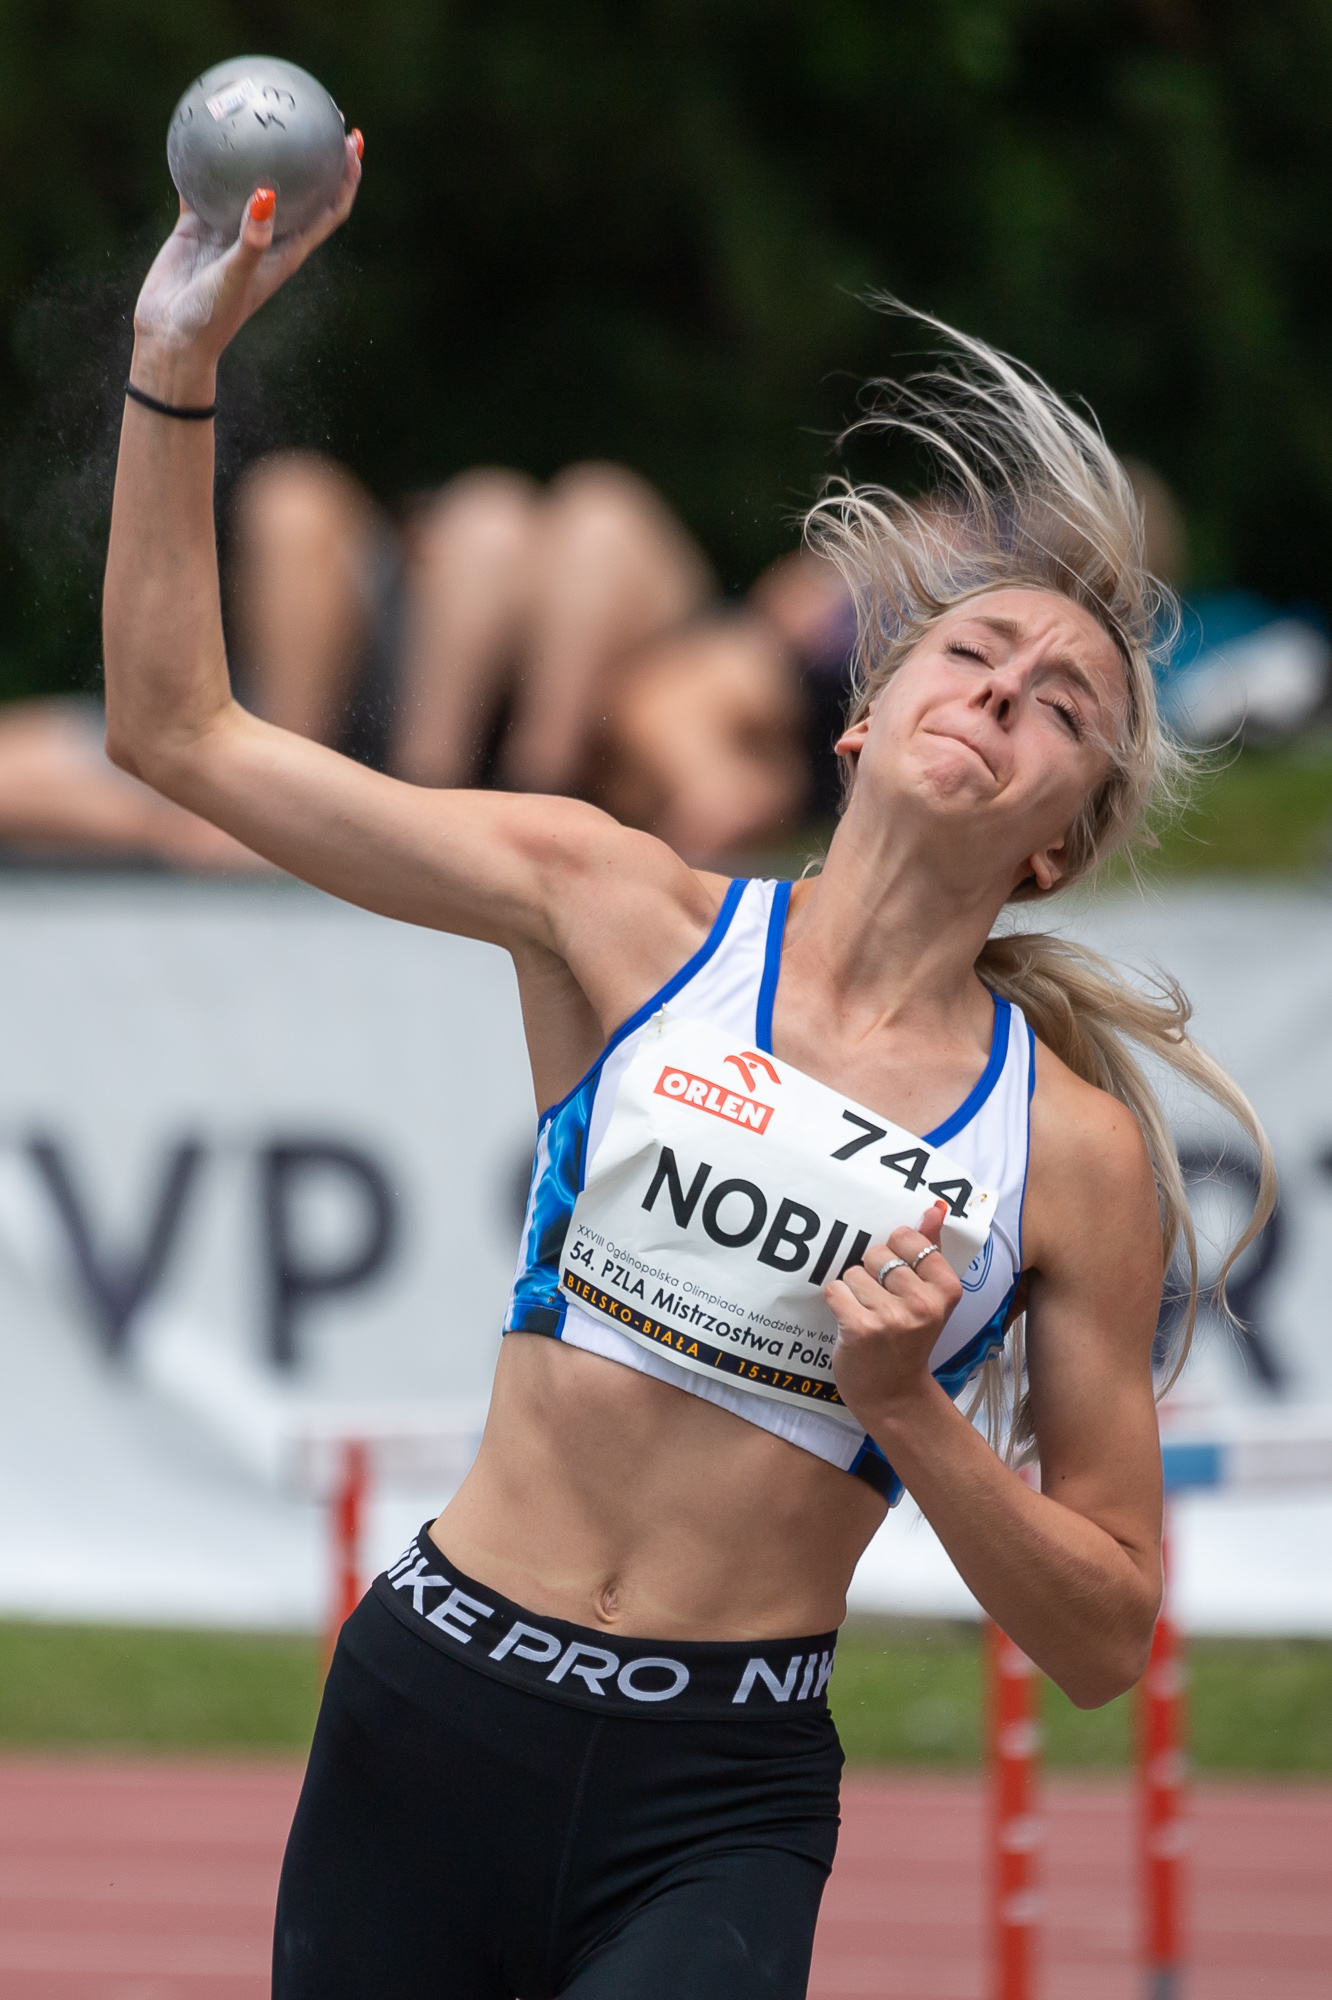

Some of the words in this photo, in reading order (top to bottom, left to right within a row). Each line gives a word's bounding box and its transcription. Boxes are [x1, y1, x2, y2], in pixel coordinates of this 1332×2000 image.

[662, 1072, 766, 1129] ORLEN
[830, 1109, 973, 1218] 744
[566, 1274, 698, 1357] BIELSKO-BIAŁA
[570, 1240, 594, 1271] 54.
[601, 1259, 645, 1300] PZLA
[651, 1287, 784, 1357] Mistrzostwa
[577, 1224, 605, 1247] XXVIII
[606, 1241, 679, 1287] Ogólnopolska
[682, 1281, 745, 1317] Olimpiada
[747, 1311, 804, 1337] Młodzieży
[807, 1329, 817, 1339] w
[387, 1539, 495, 1644] IKE
[488, 1621, 690, 1702] PRO
